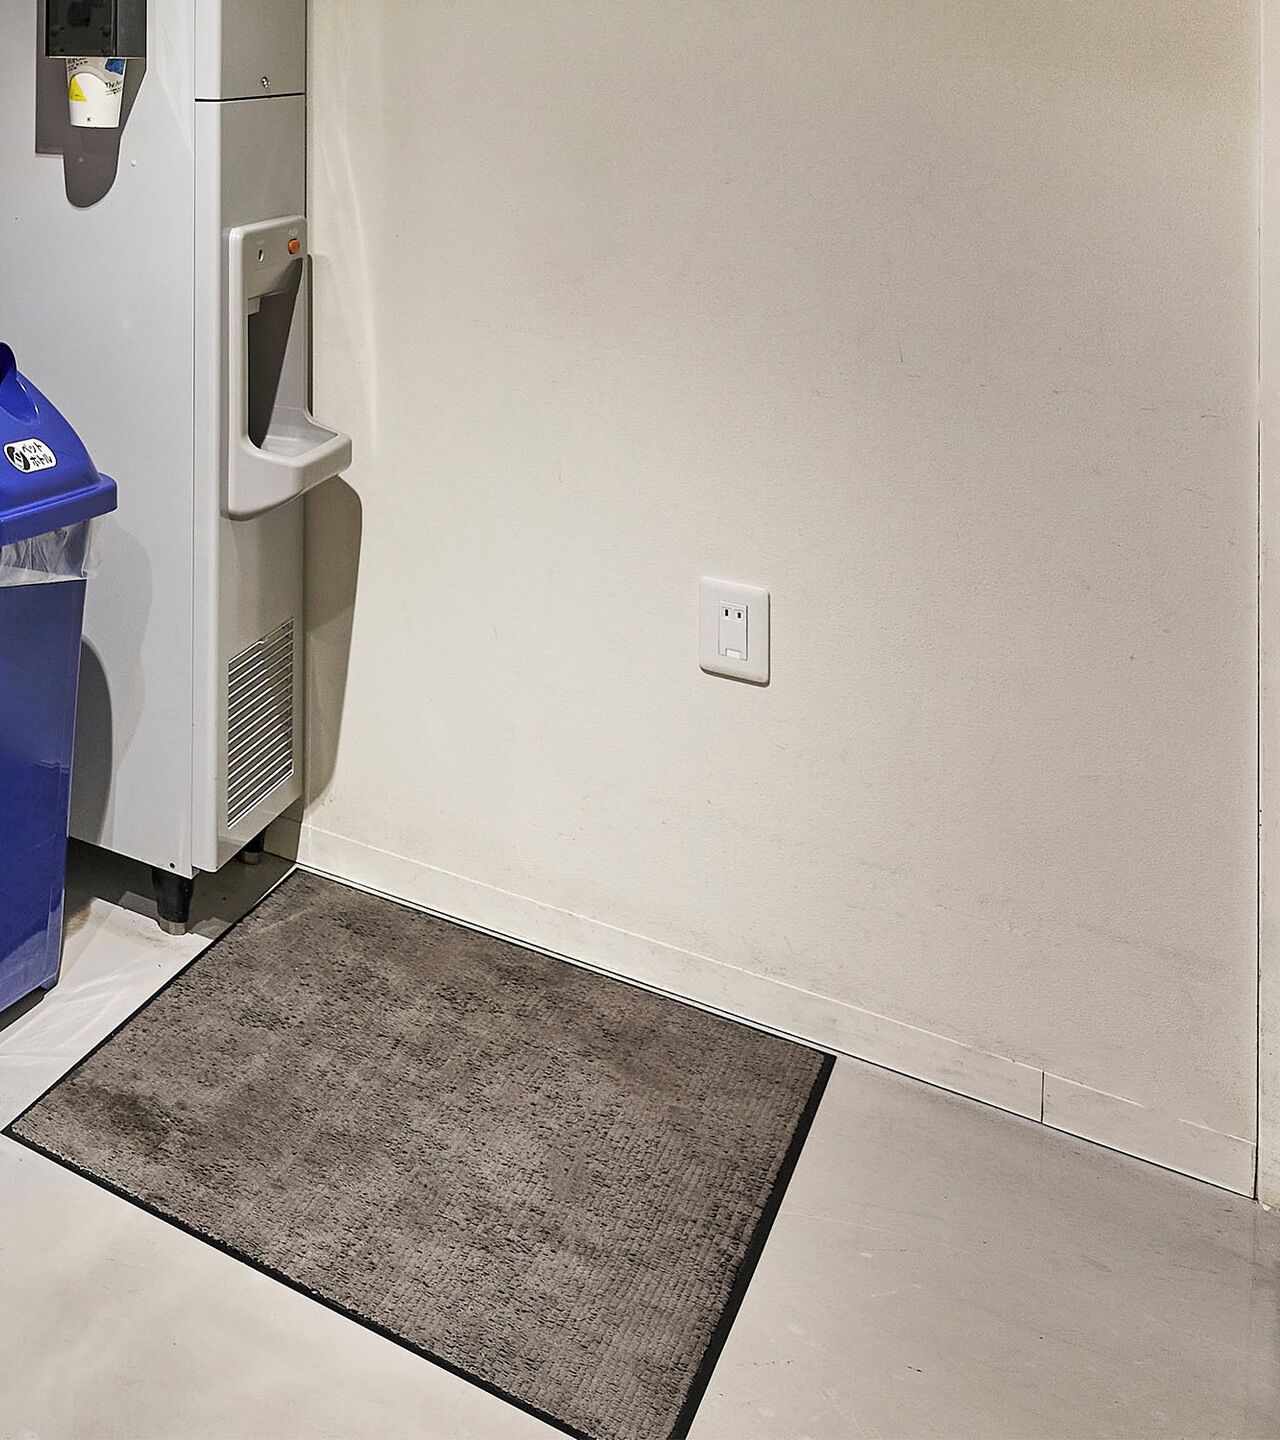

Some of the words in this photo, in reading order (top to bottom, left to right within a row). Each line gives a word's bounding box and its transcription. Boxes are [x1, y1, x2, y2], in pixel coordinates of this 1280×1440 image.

[22, 442, 43, 454] ペット
[29, 453, 53, 468] ボトル
